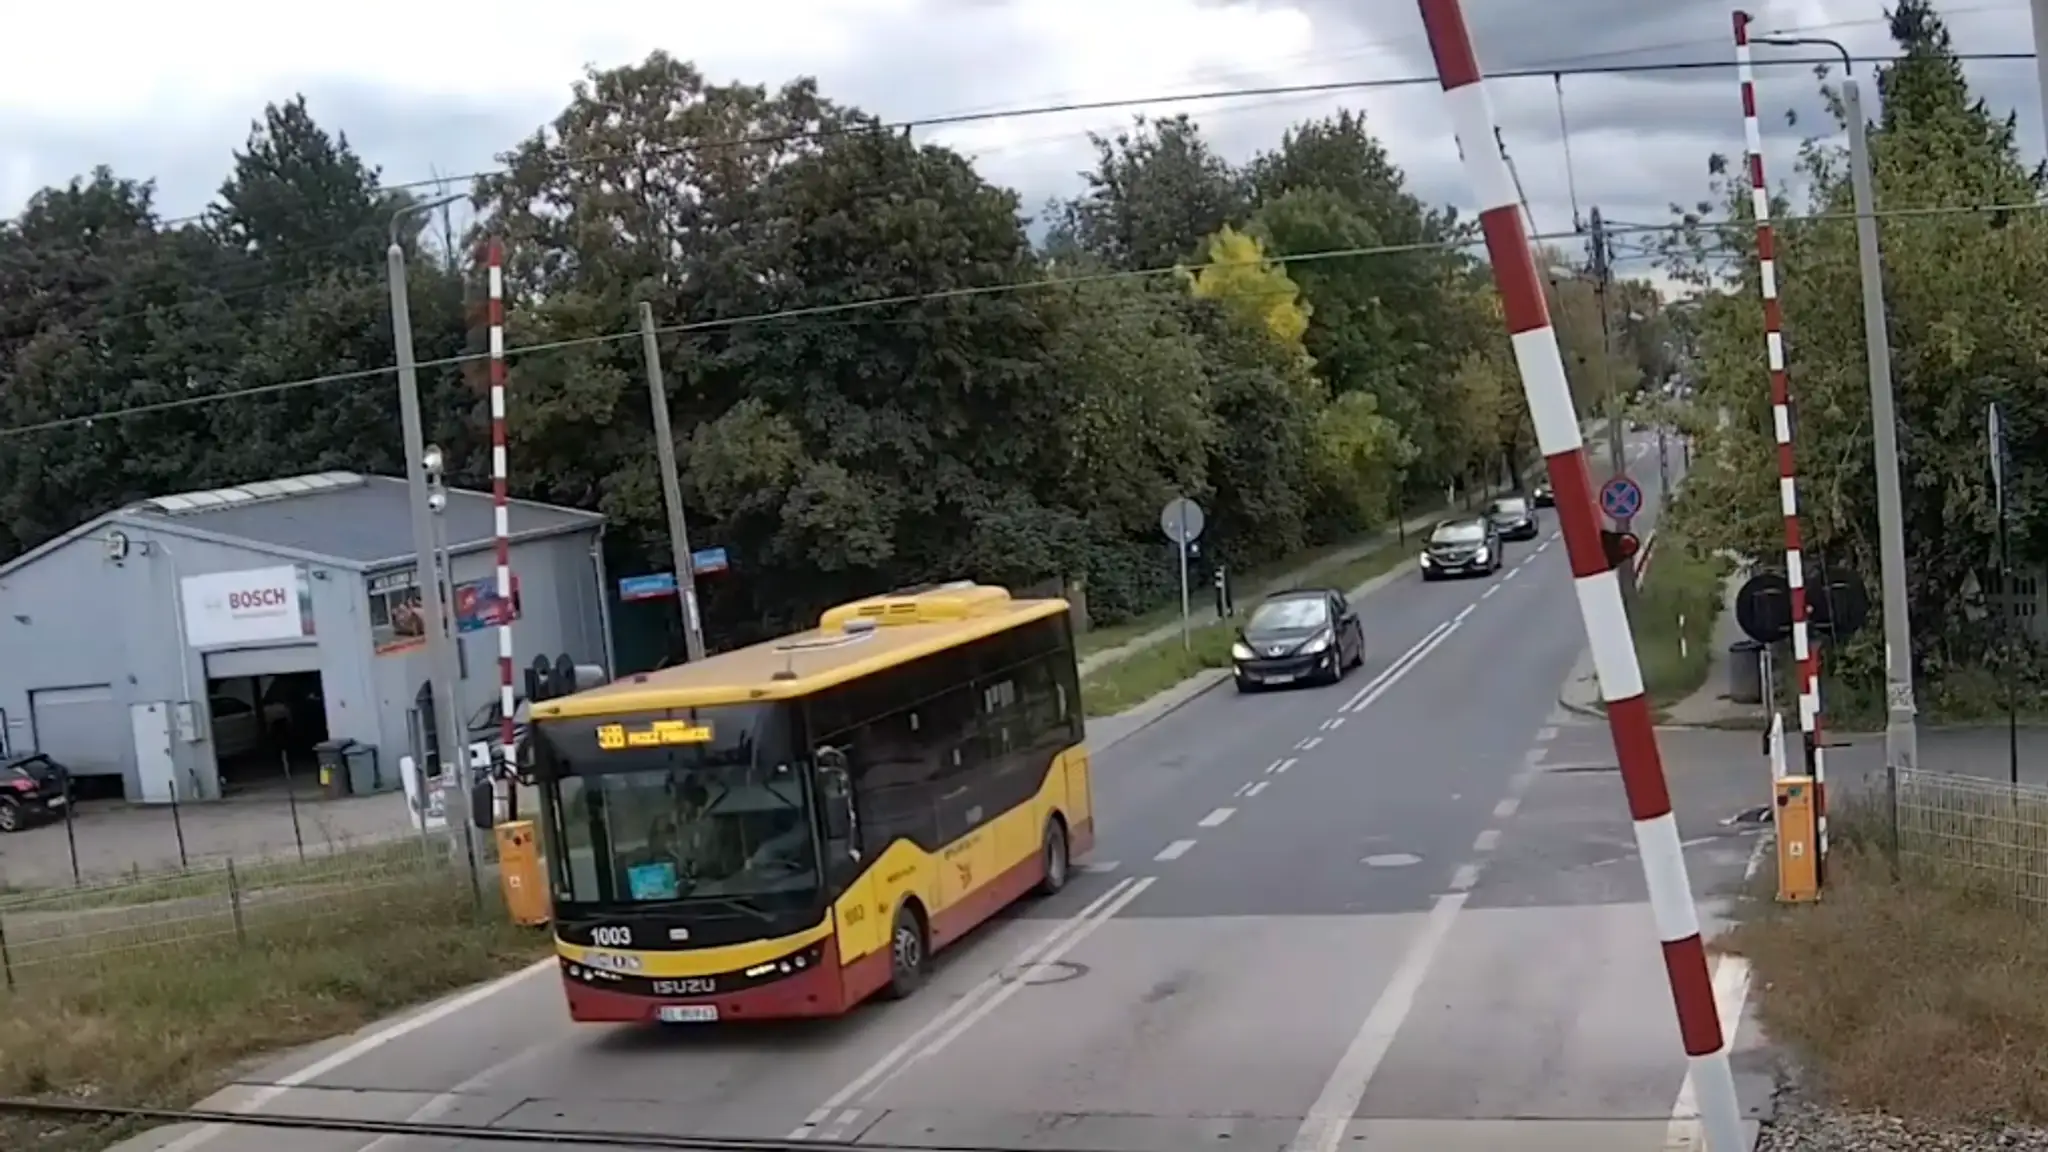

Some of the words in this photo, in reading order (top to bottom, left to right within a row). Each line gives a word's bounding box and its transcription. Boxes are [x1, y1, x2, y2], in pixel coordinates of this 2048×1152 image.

[228, 587, 286, 609] BOSCH
[590, 926, 632, 945] 1003
[653, 978, 716, 994] ISUZU
